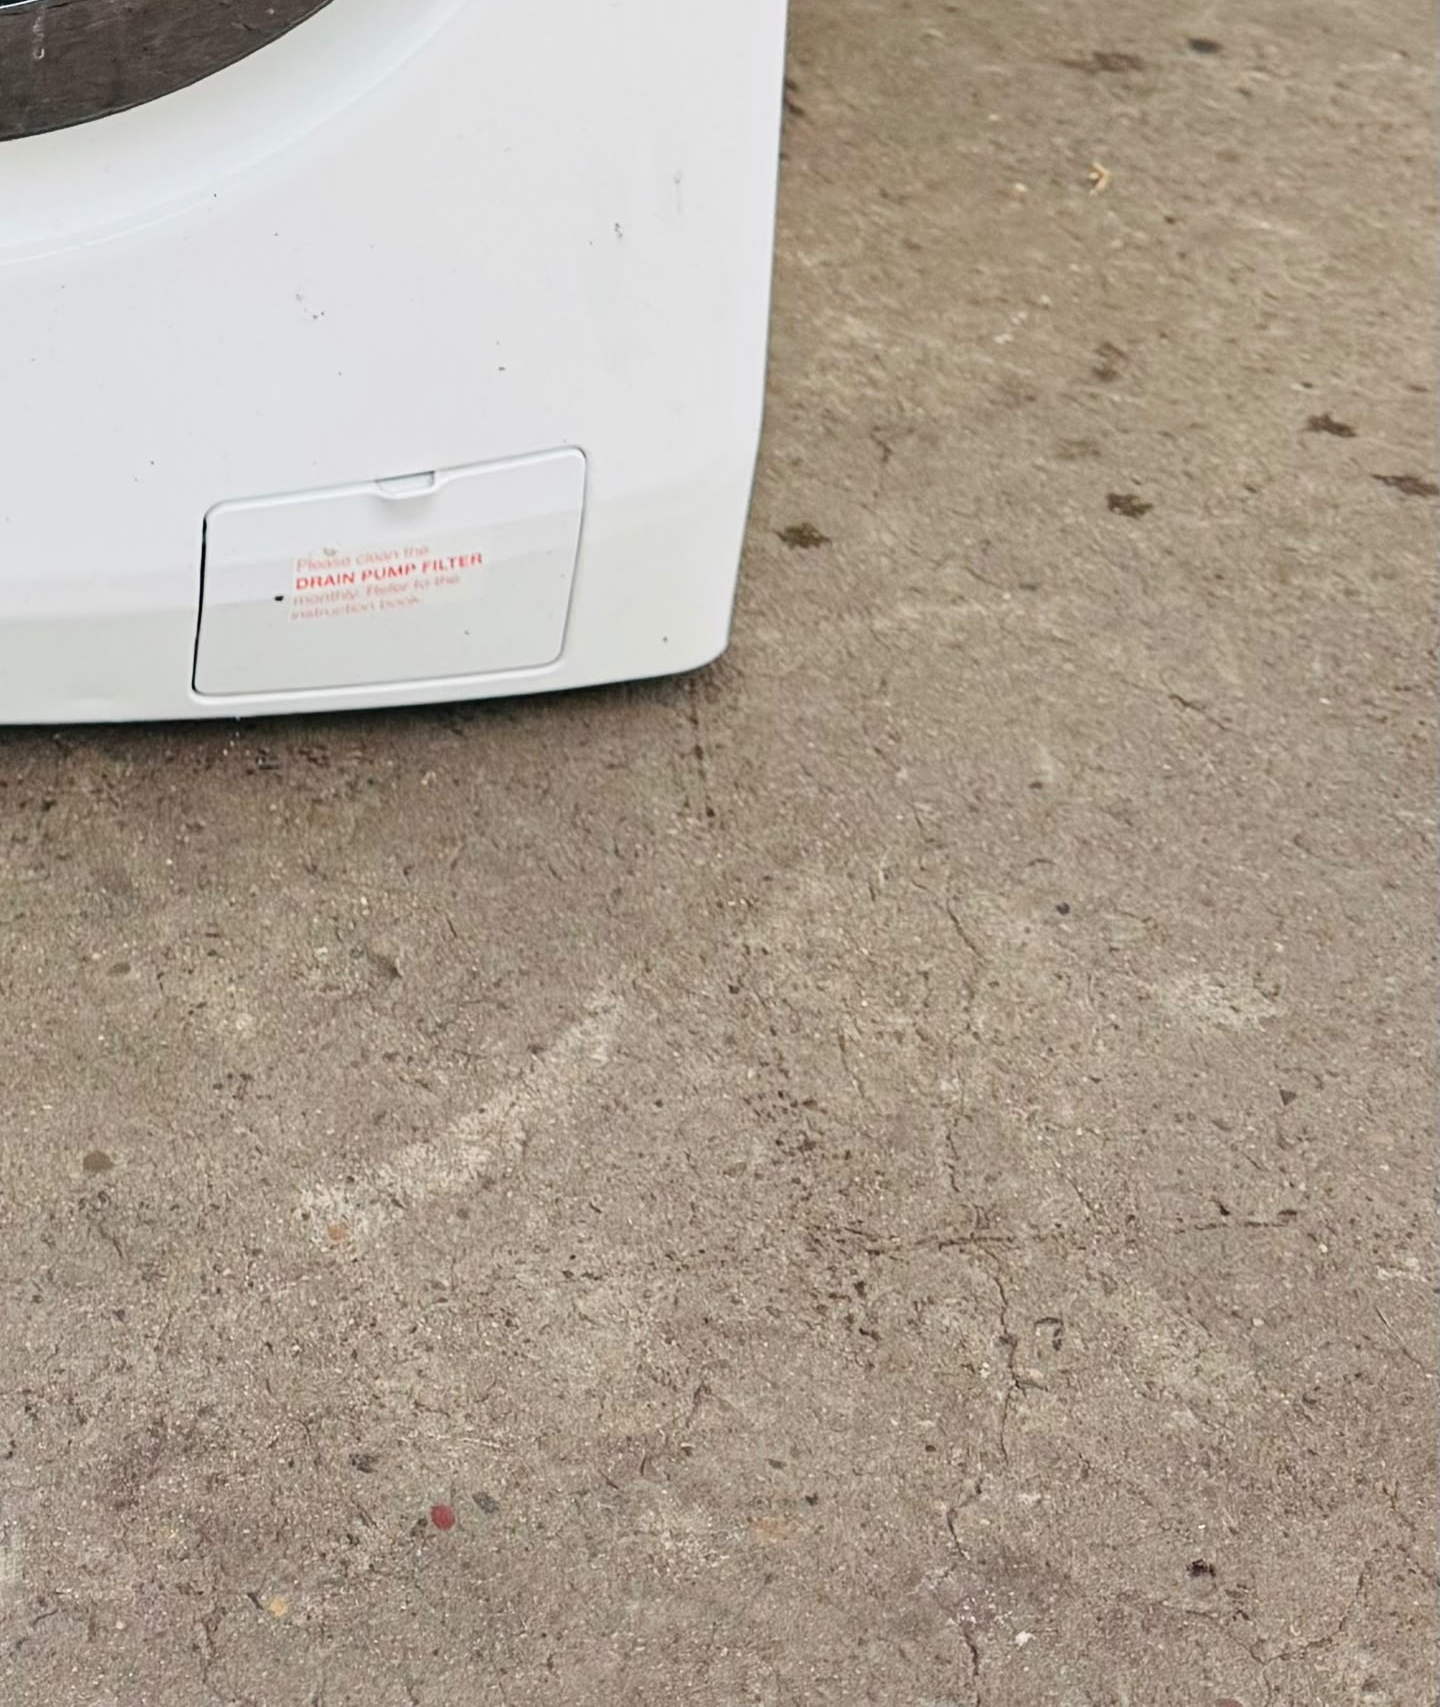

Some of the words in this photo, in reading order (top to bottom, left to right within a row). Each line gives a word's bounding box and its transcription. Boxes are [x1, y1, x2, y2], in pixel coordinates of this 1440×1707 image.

[296, 572, 355, 591] DRAIN
[361, 564, 416, 582] PUMP
[422, 552, 482, 574] FILTER
